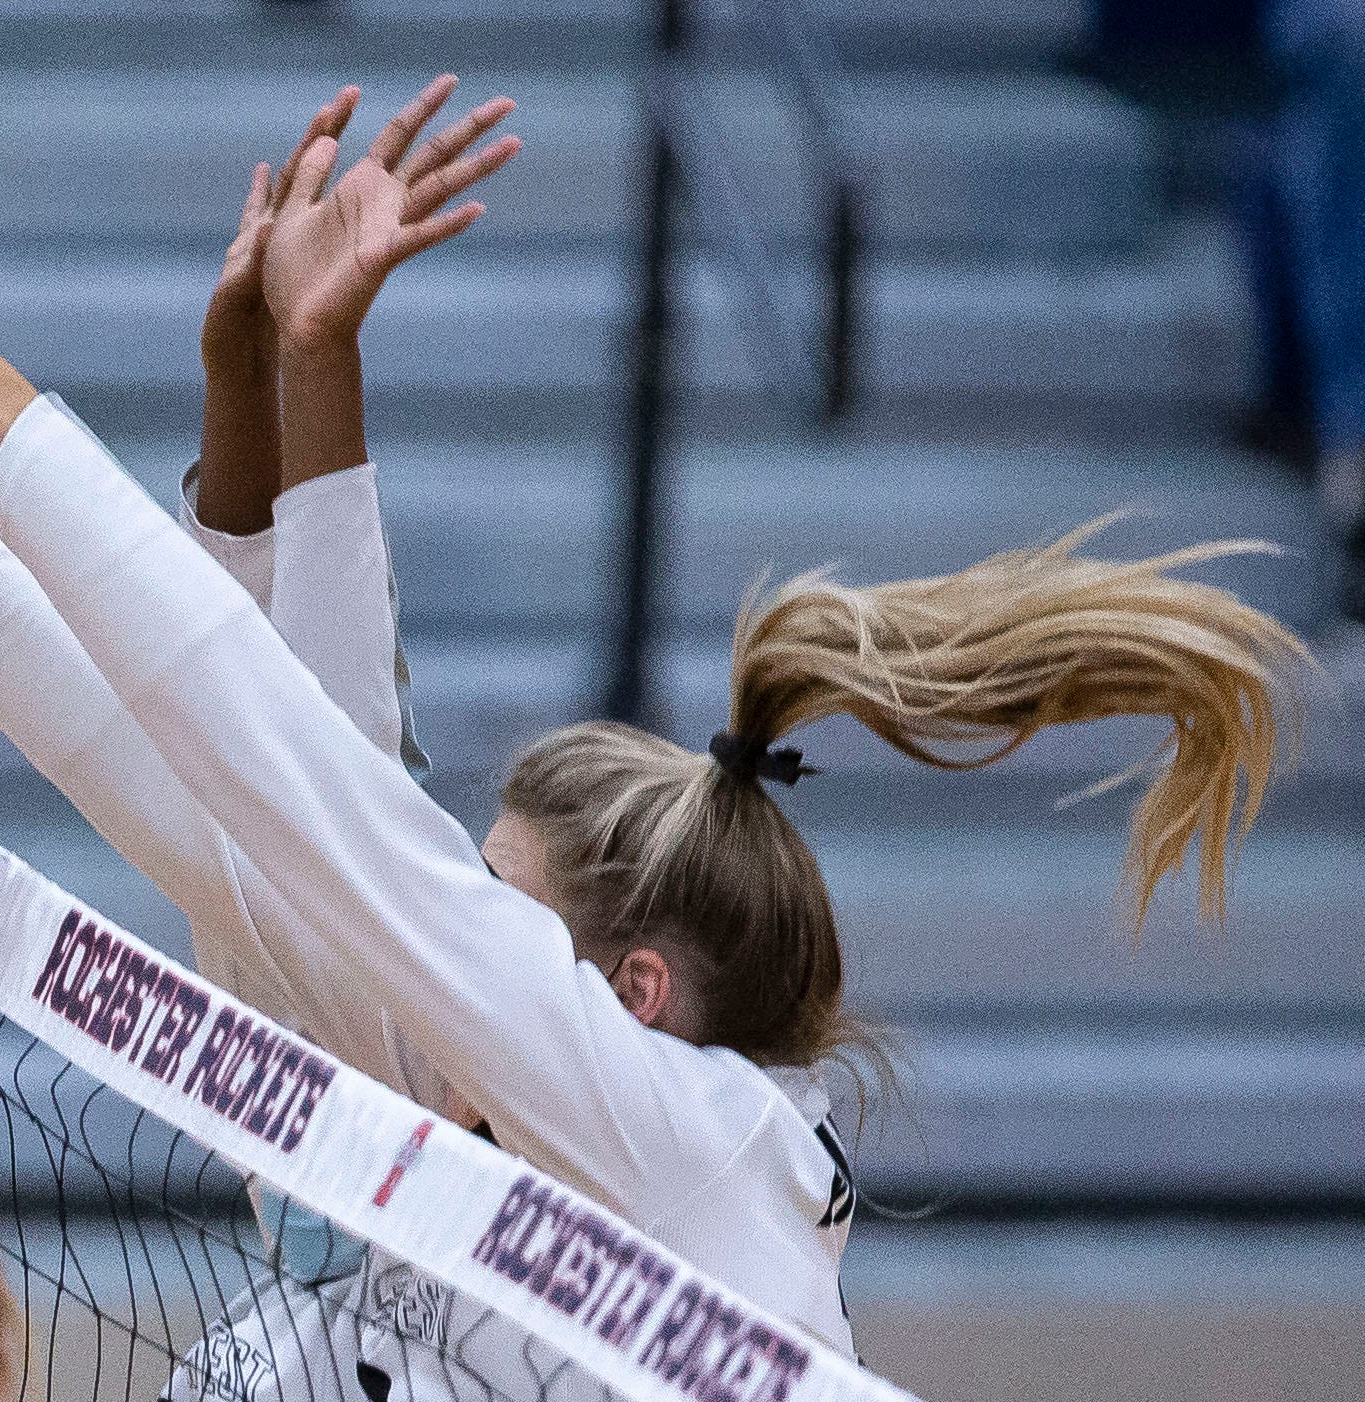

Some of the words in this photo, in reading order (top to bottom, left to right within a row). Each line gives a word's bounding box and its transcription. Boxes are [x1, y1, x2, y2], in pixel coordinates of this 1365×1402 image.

[32, 908, 211, 1084] ROCHESTER
[181, 1005, 337, 1154] ROCKETS
[470, 1175, 676, 1353] ROCHESTER
